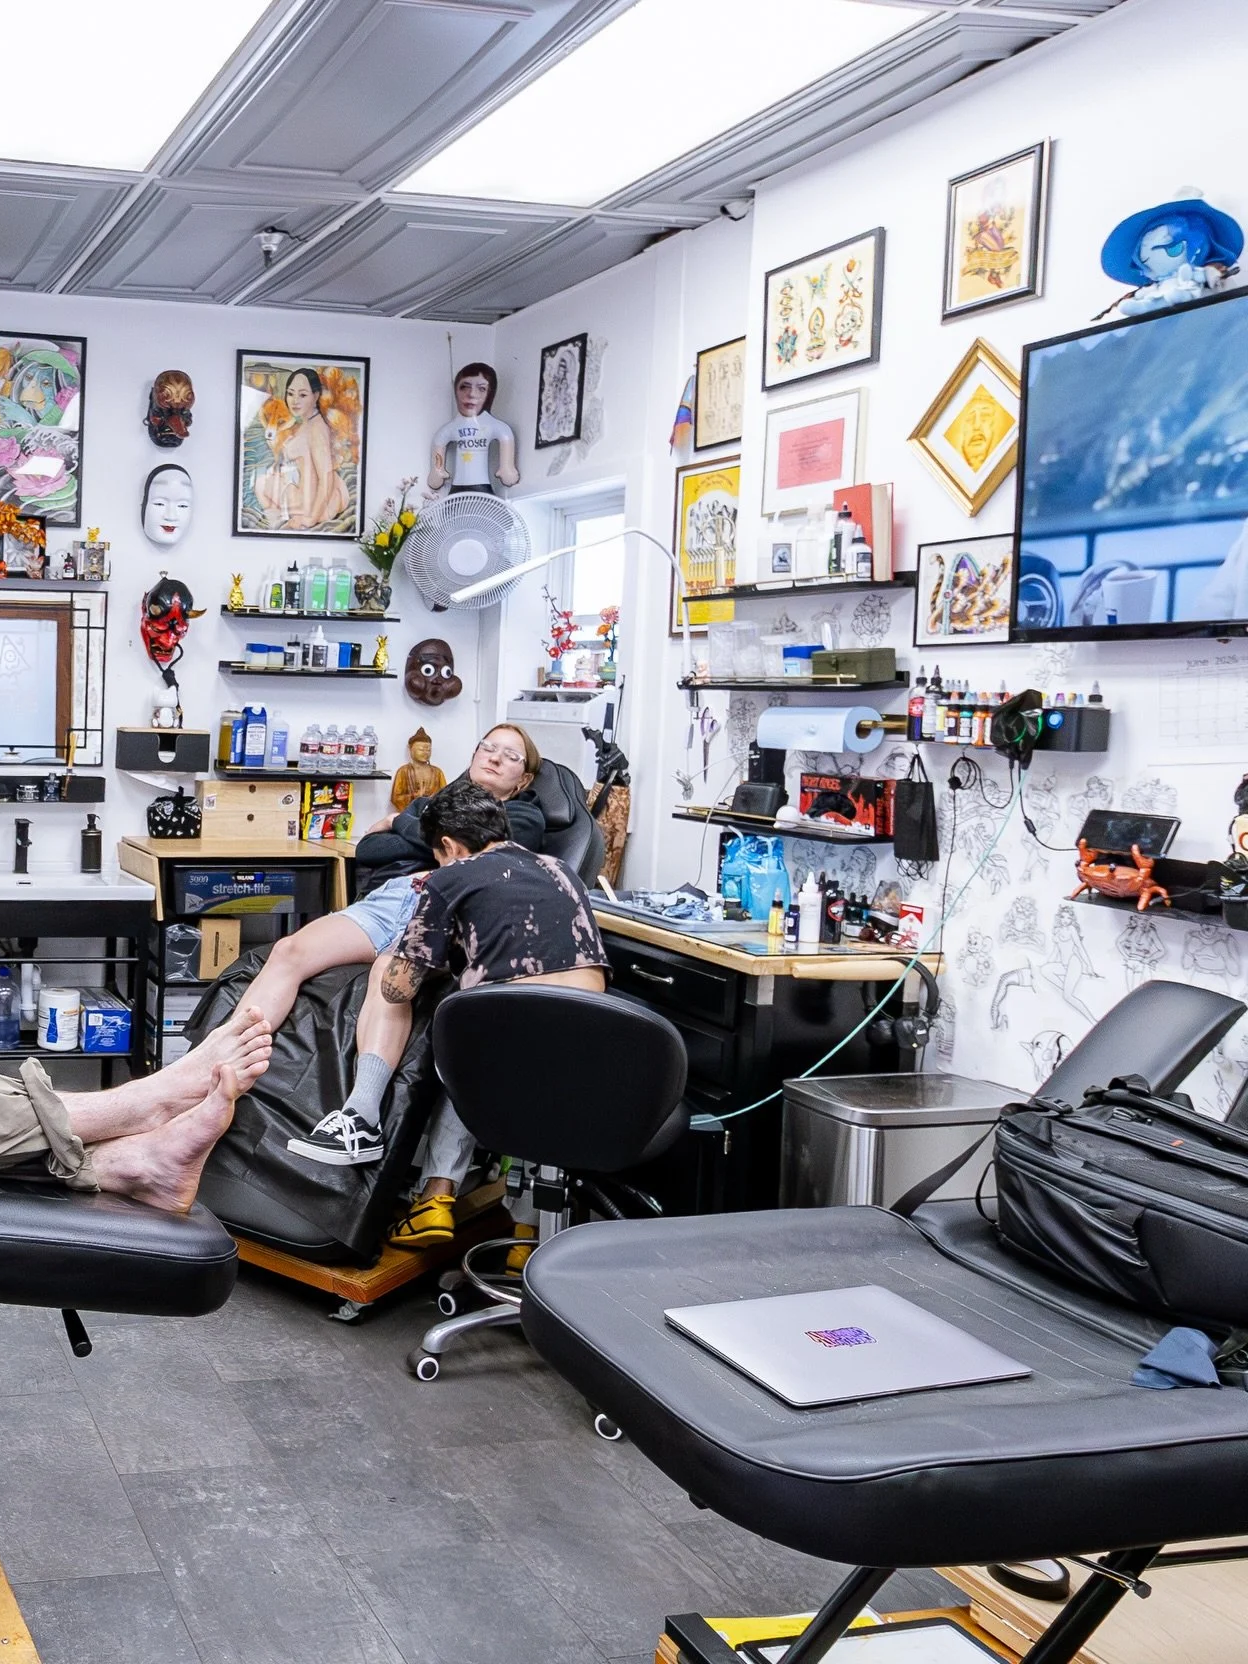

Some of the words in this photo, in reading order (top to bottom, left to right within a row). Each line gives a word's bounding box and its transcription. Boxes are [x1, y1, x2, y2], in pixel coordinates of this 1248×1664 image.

[458, 428, 479, 438] BEST
[457, 438, 487, 449] PLOYEE
[212, 883, 271, 895] stretch-tite
